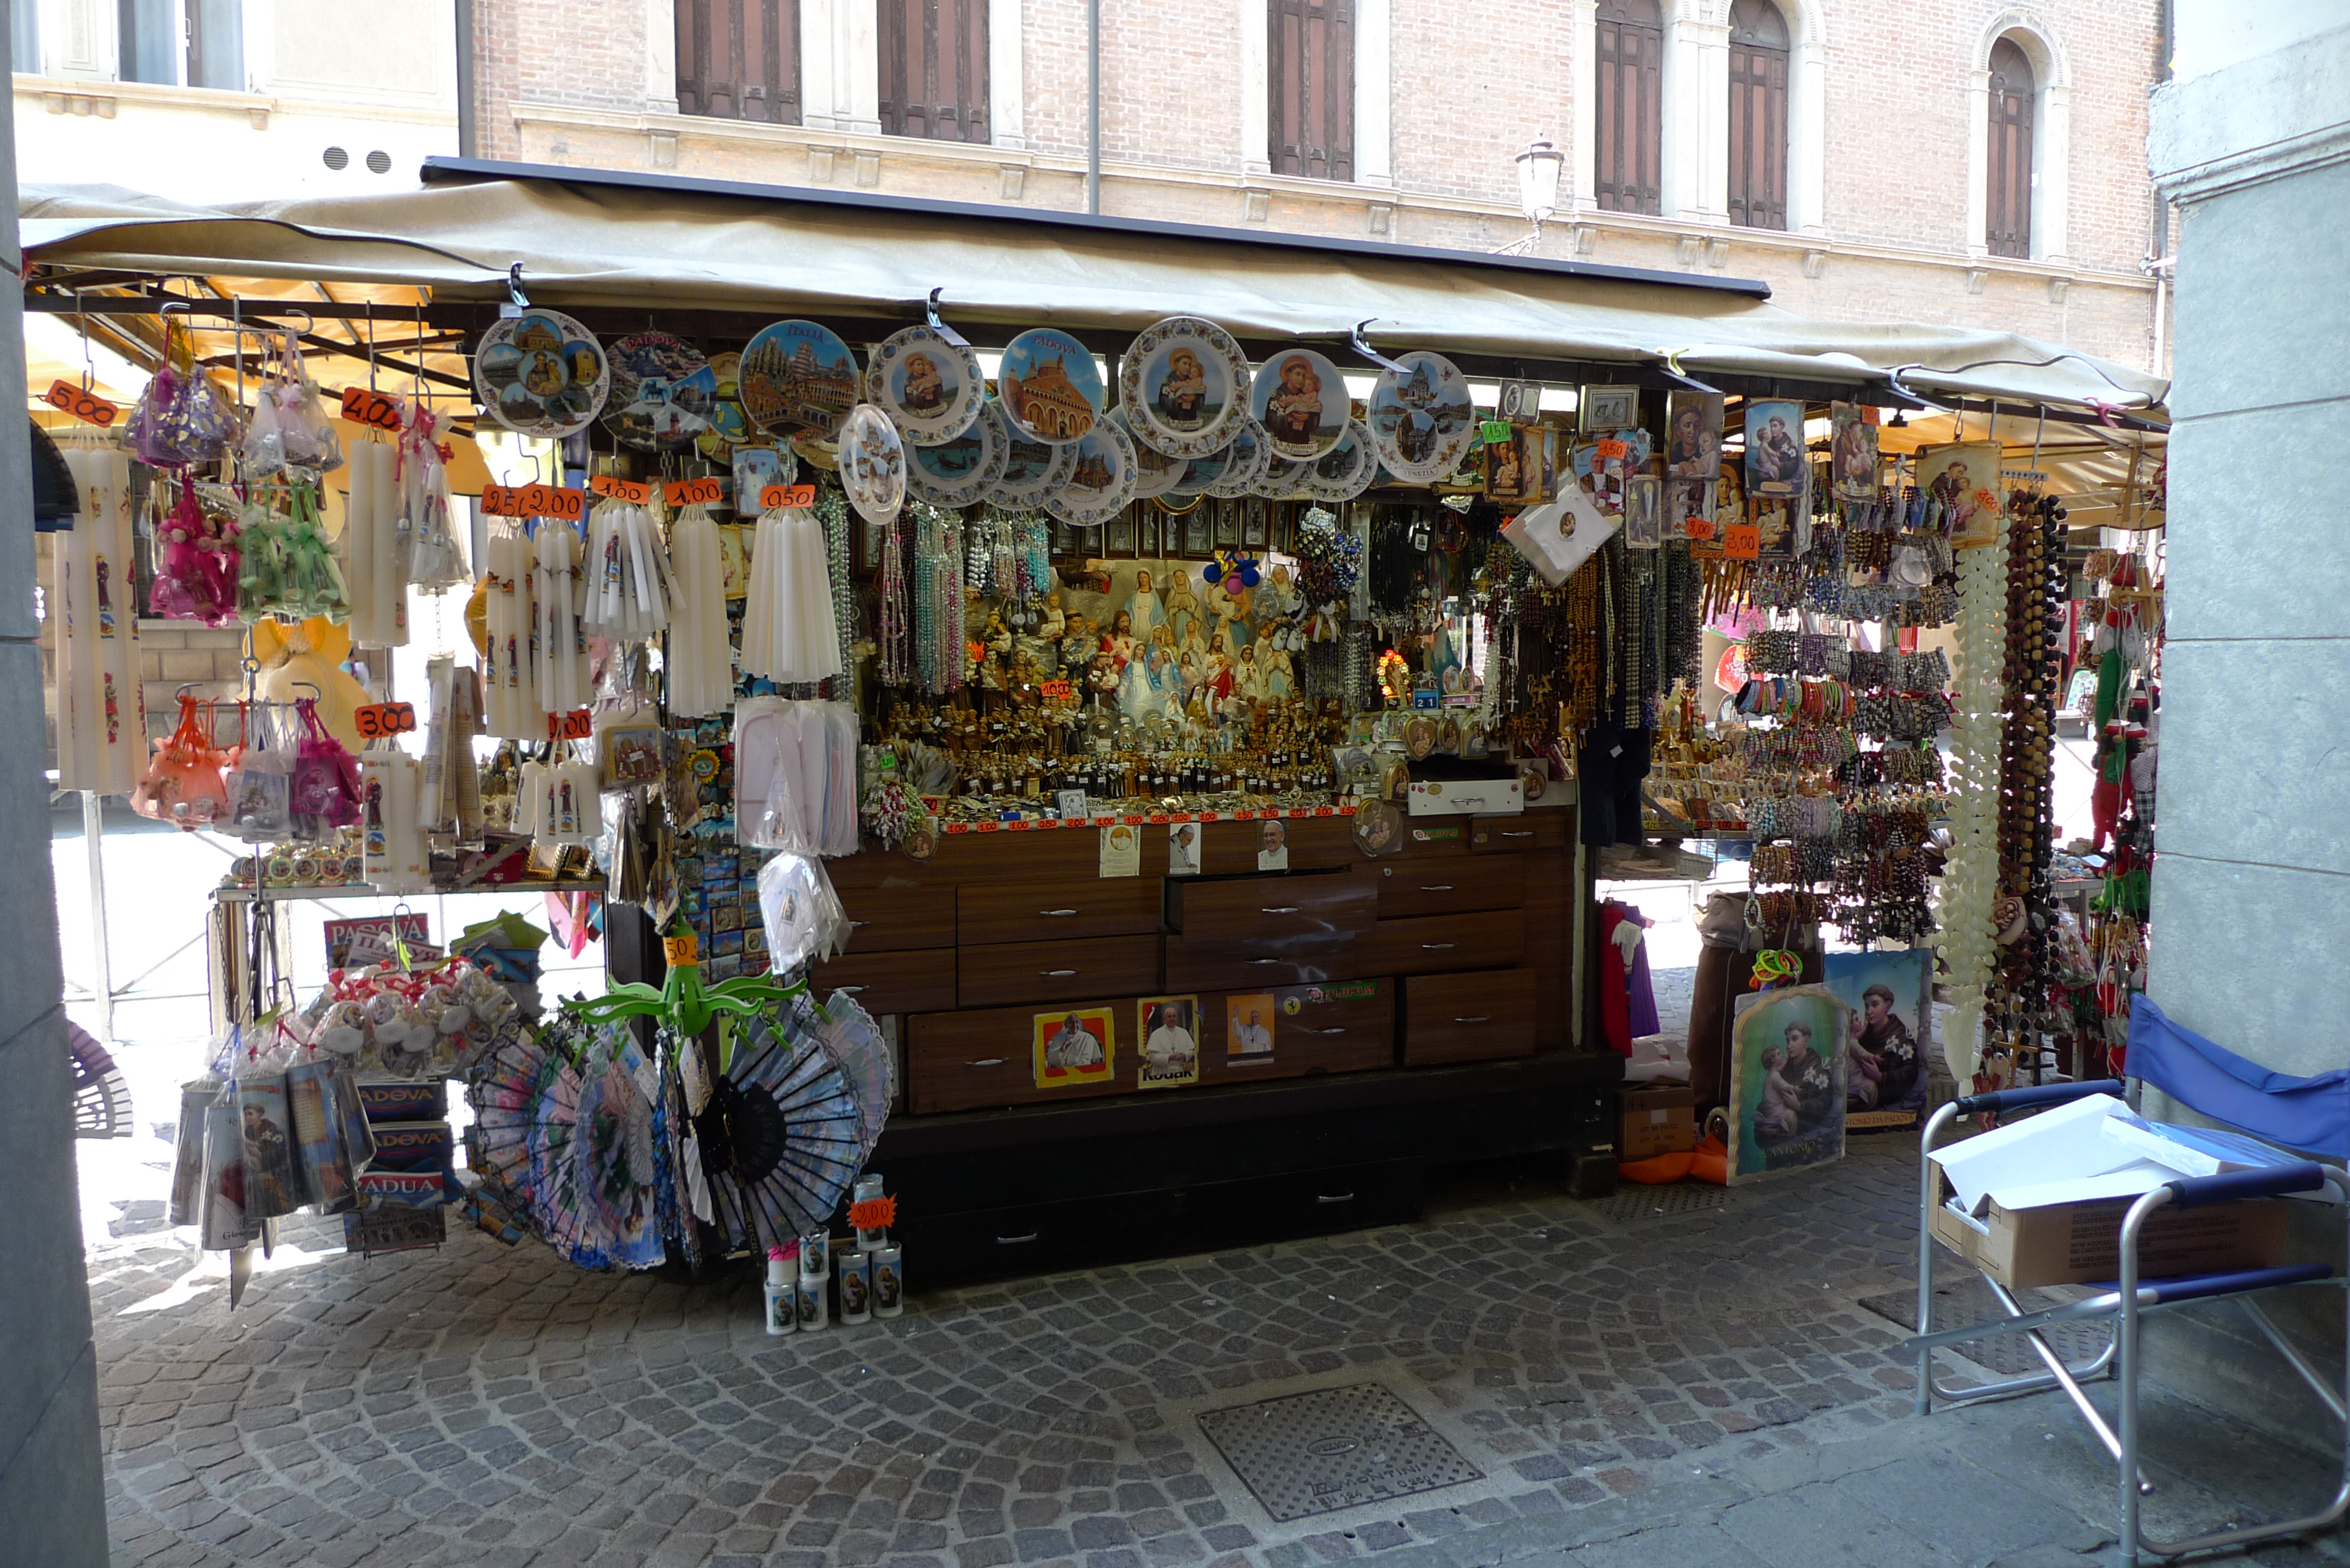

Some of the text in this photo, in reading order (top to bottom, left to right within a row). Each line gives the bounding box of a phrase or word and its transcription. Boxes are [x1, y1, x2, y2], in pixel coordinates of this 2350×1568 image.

[787, 324, 823, 343] ITALIA
[625, 334, 682, 350] PADOVA
[1034, 335, 1077, 355] PADOVA
[530, 426, 566, 435] PADOVA
[1488, 423, 1508, 440] 1,50
[1599, 443, 1623, 455] 1,50
[1403, 469, 1435, 478] VENEZIA
[529, 489, 581, 515] 2,00
[673, 483, 720, 505] 1,00
[767, 490, 810, 508] 0,50
[1727, 531, 1755, 553] 3,00
[361, 706, 415, 736] 3.00
[1323, 985, 1374, 999] FUJIFILM
[360, 1089, 434, 1102] ADOVA
[1845, 1113, 1914, 1126] NTONIO DA PADOVA
[373, 1133, 442, 1147] ADOVA
[1771, 1141, 1815, 1157] ANTONIO
[855, 1203, 889, 1225] 2,00
[1339, 1464, 1421, 1488] MONTINI
[1340, 1490, 1362, 1501] 124
